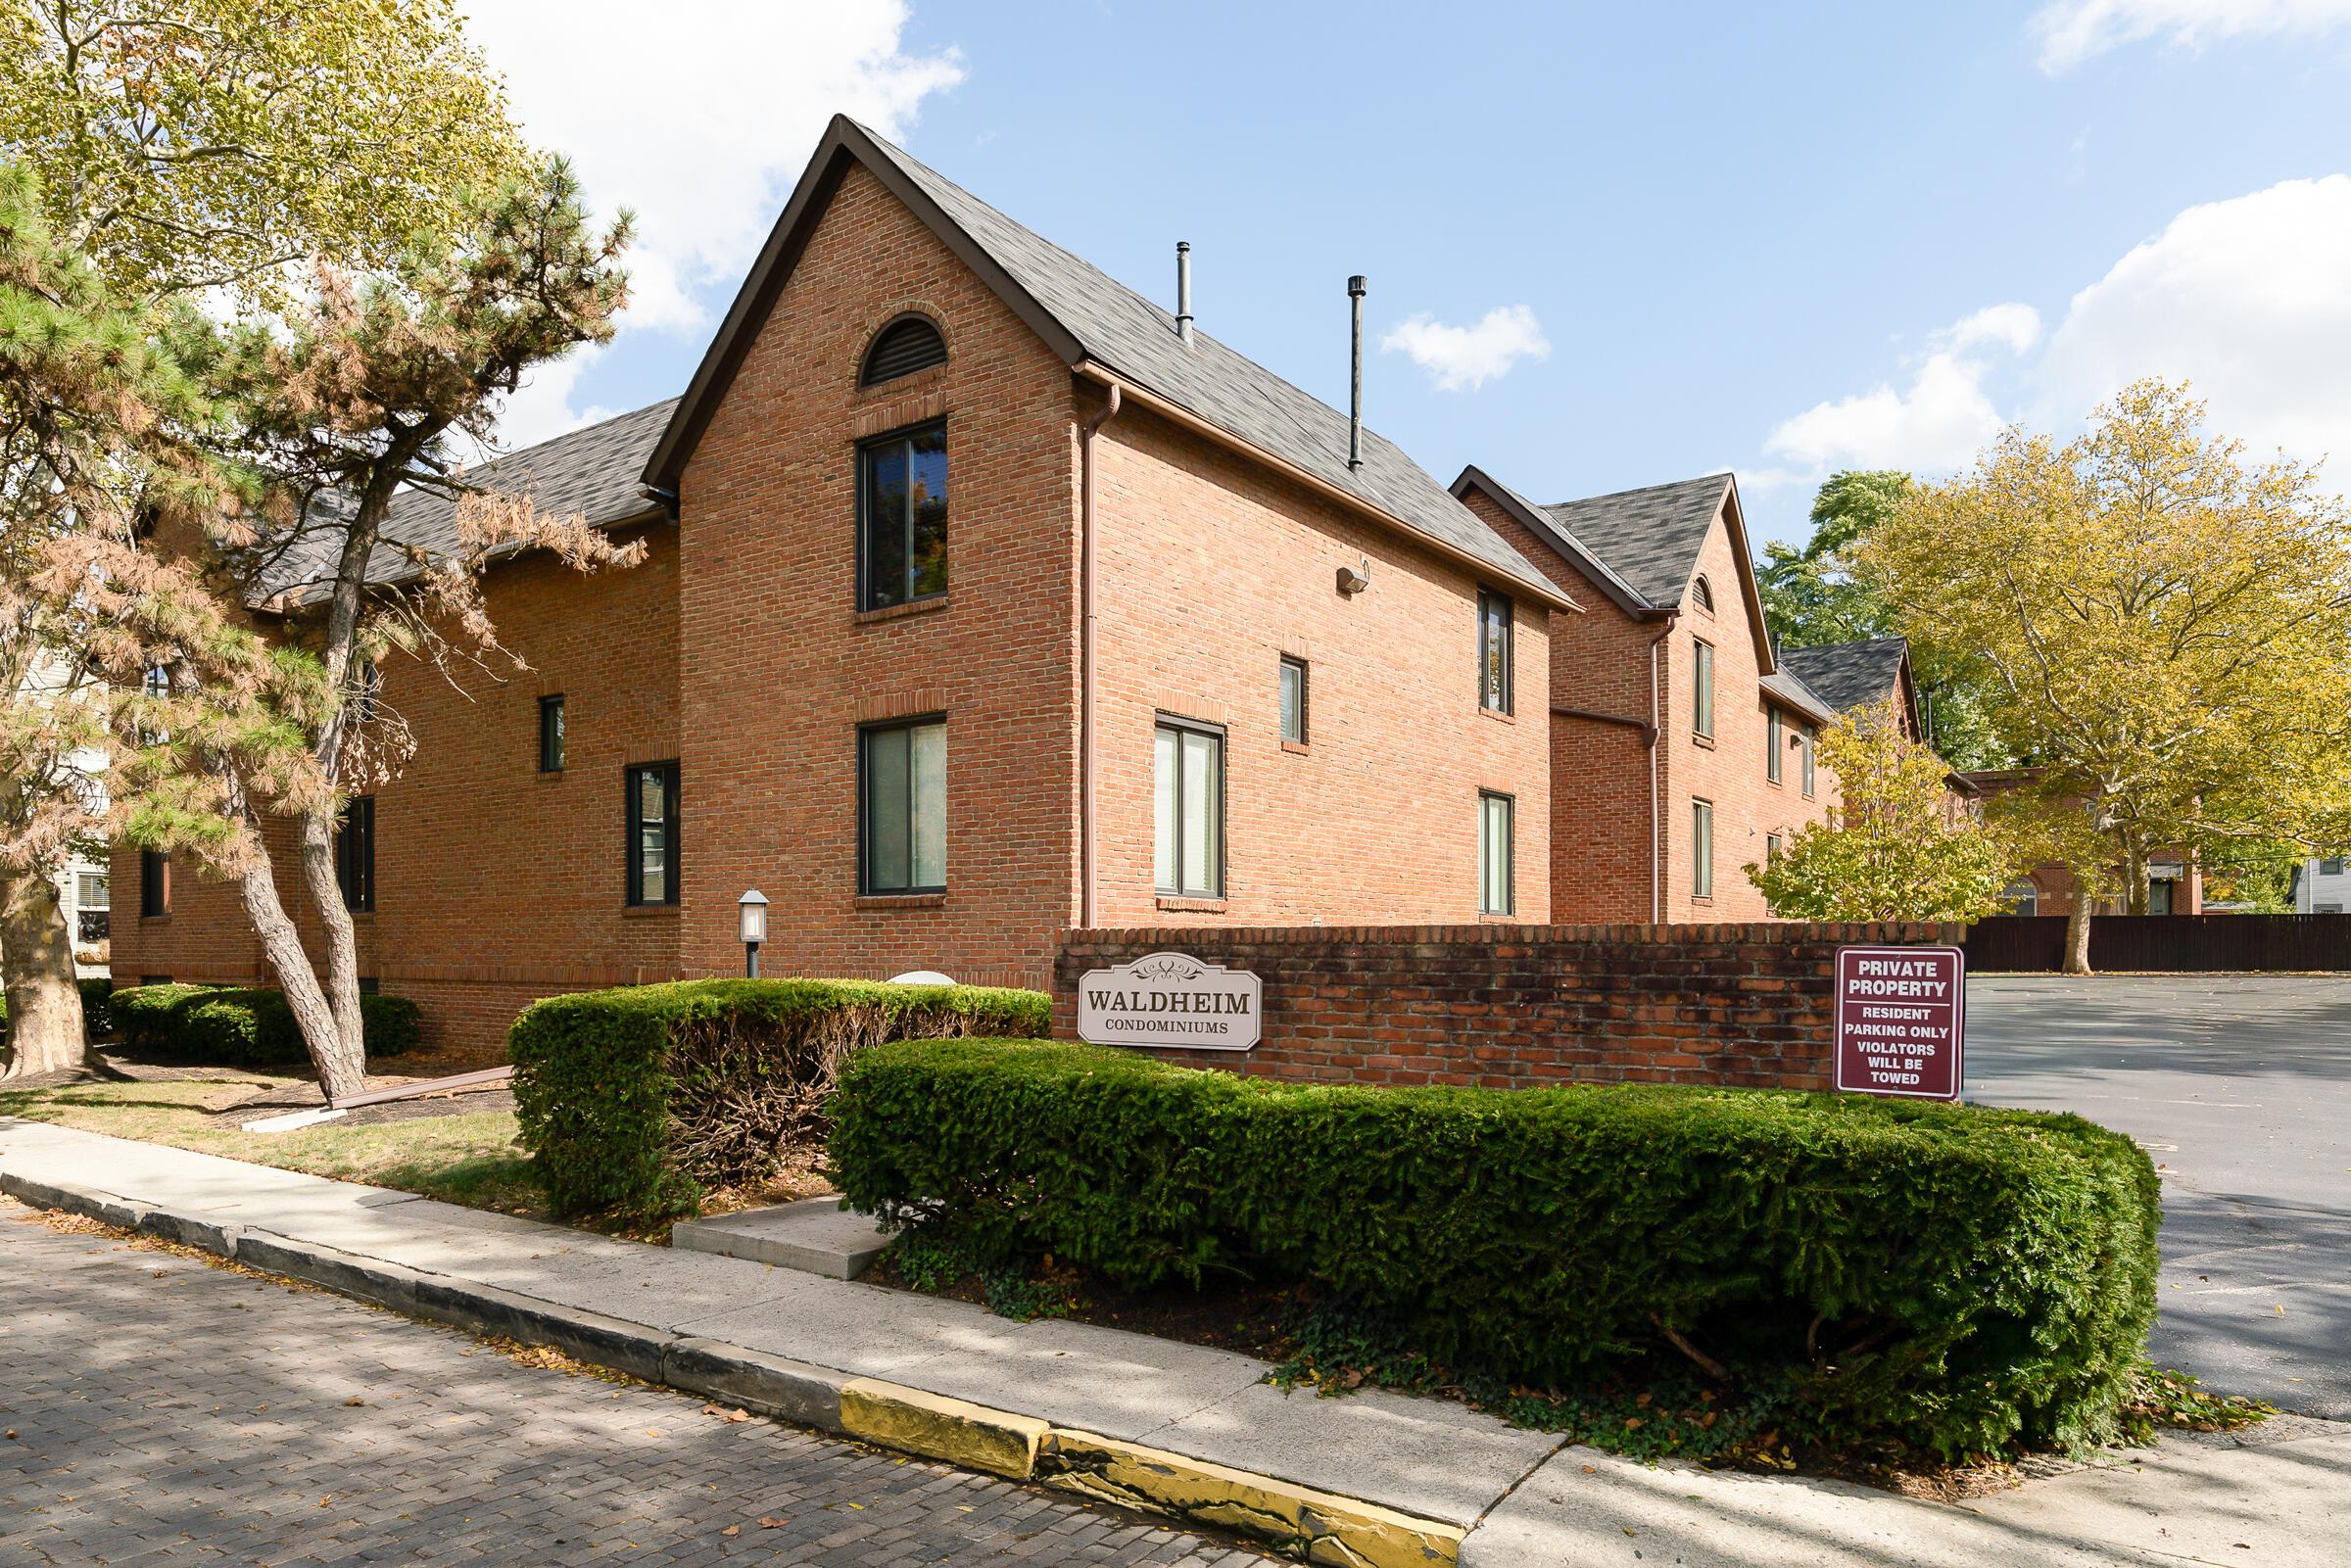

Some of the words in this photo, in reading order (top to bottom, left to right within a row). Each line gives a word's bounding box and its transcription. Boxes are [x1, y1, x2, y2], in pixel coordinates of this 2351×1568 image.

[1858, 960, 1938, 977] PRIVATE
[1848, 979, 1947, 997] PROPERTY
[1087, 990, 1251, 1015] WALDHEIM
[1862, 1007, 1932, 1021] RESIDENT
[1105, 1019, 1228, 1034] CONDOMINIUMS
[1845, 1023, 1906, 1037] PARKING
[1909, 1026, 1949, 1039] ONLY
[1857, 1041, 1936, 1056] VIOLATORS
[1867, 1056, 1900, 1069] WILL
[1904, 1059, 1923, 1070] BE
[1870, 1070, 1920, 1085] TOWED
